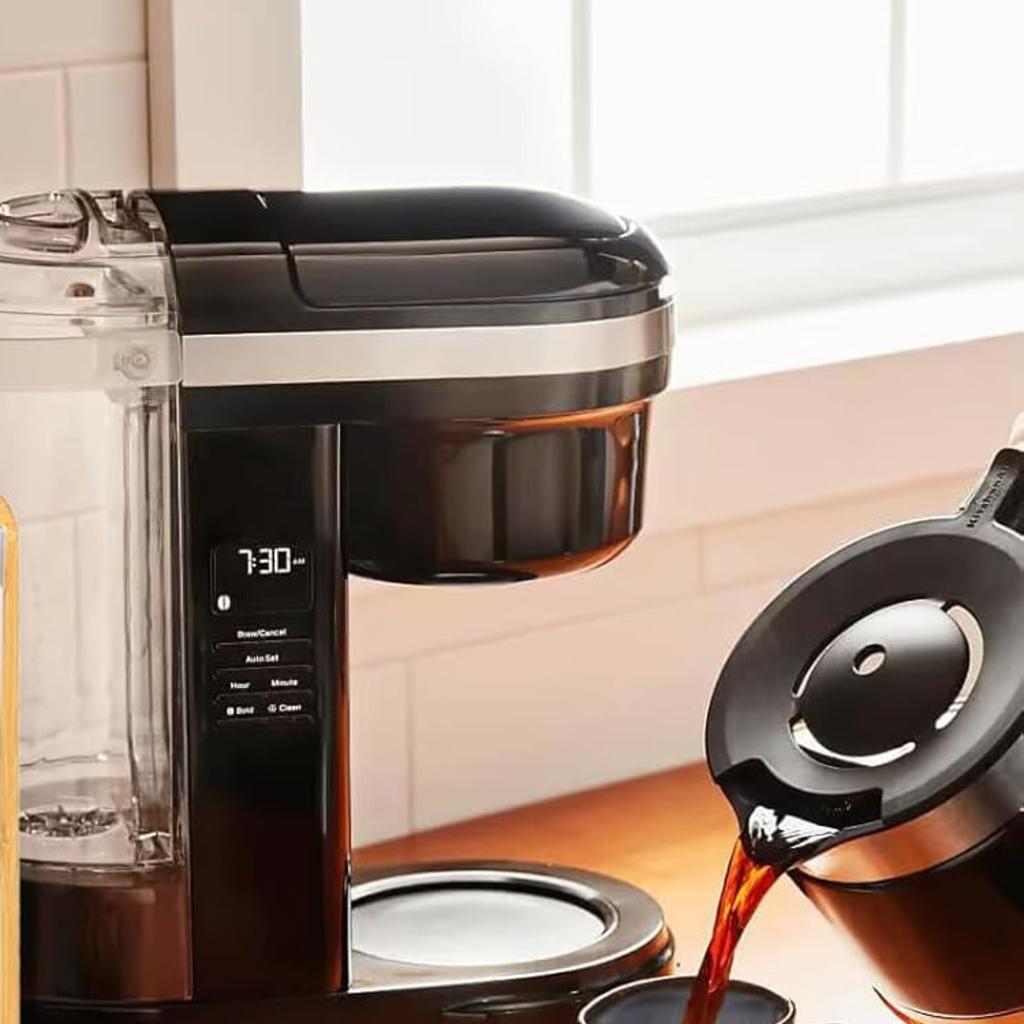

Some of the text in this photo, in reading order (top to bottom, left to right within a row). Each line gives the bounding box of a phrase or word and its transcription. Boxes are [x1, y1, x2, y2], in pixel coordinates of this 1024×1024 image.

[238, 548, 291, 574] 7:30
[236, 628, 288, 638] Brew/Cancel
[245, 653, 280, 664] Auto Set
[271, 679, 299, 687] Minute
[236, 706, 255, 715] Bold
[279, 704, 302, 712] Clean
